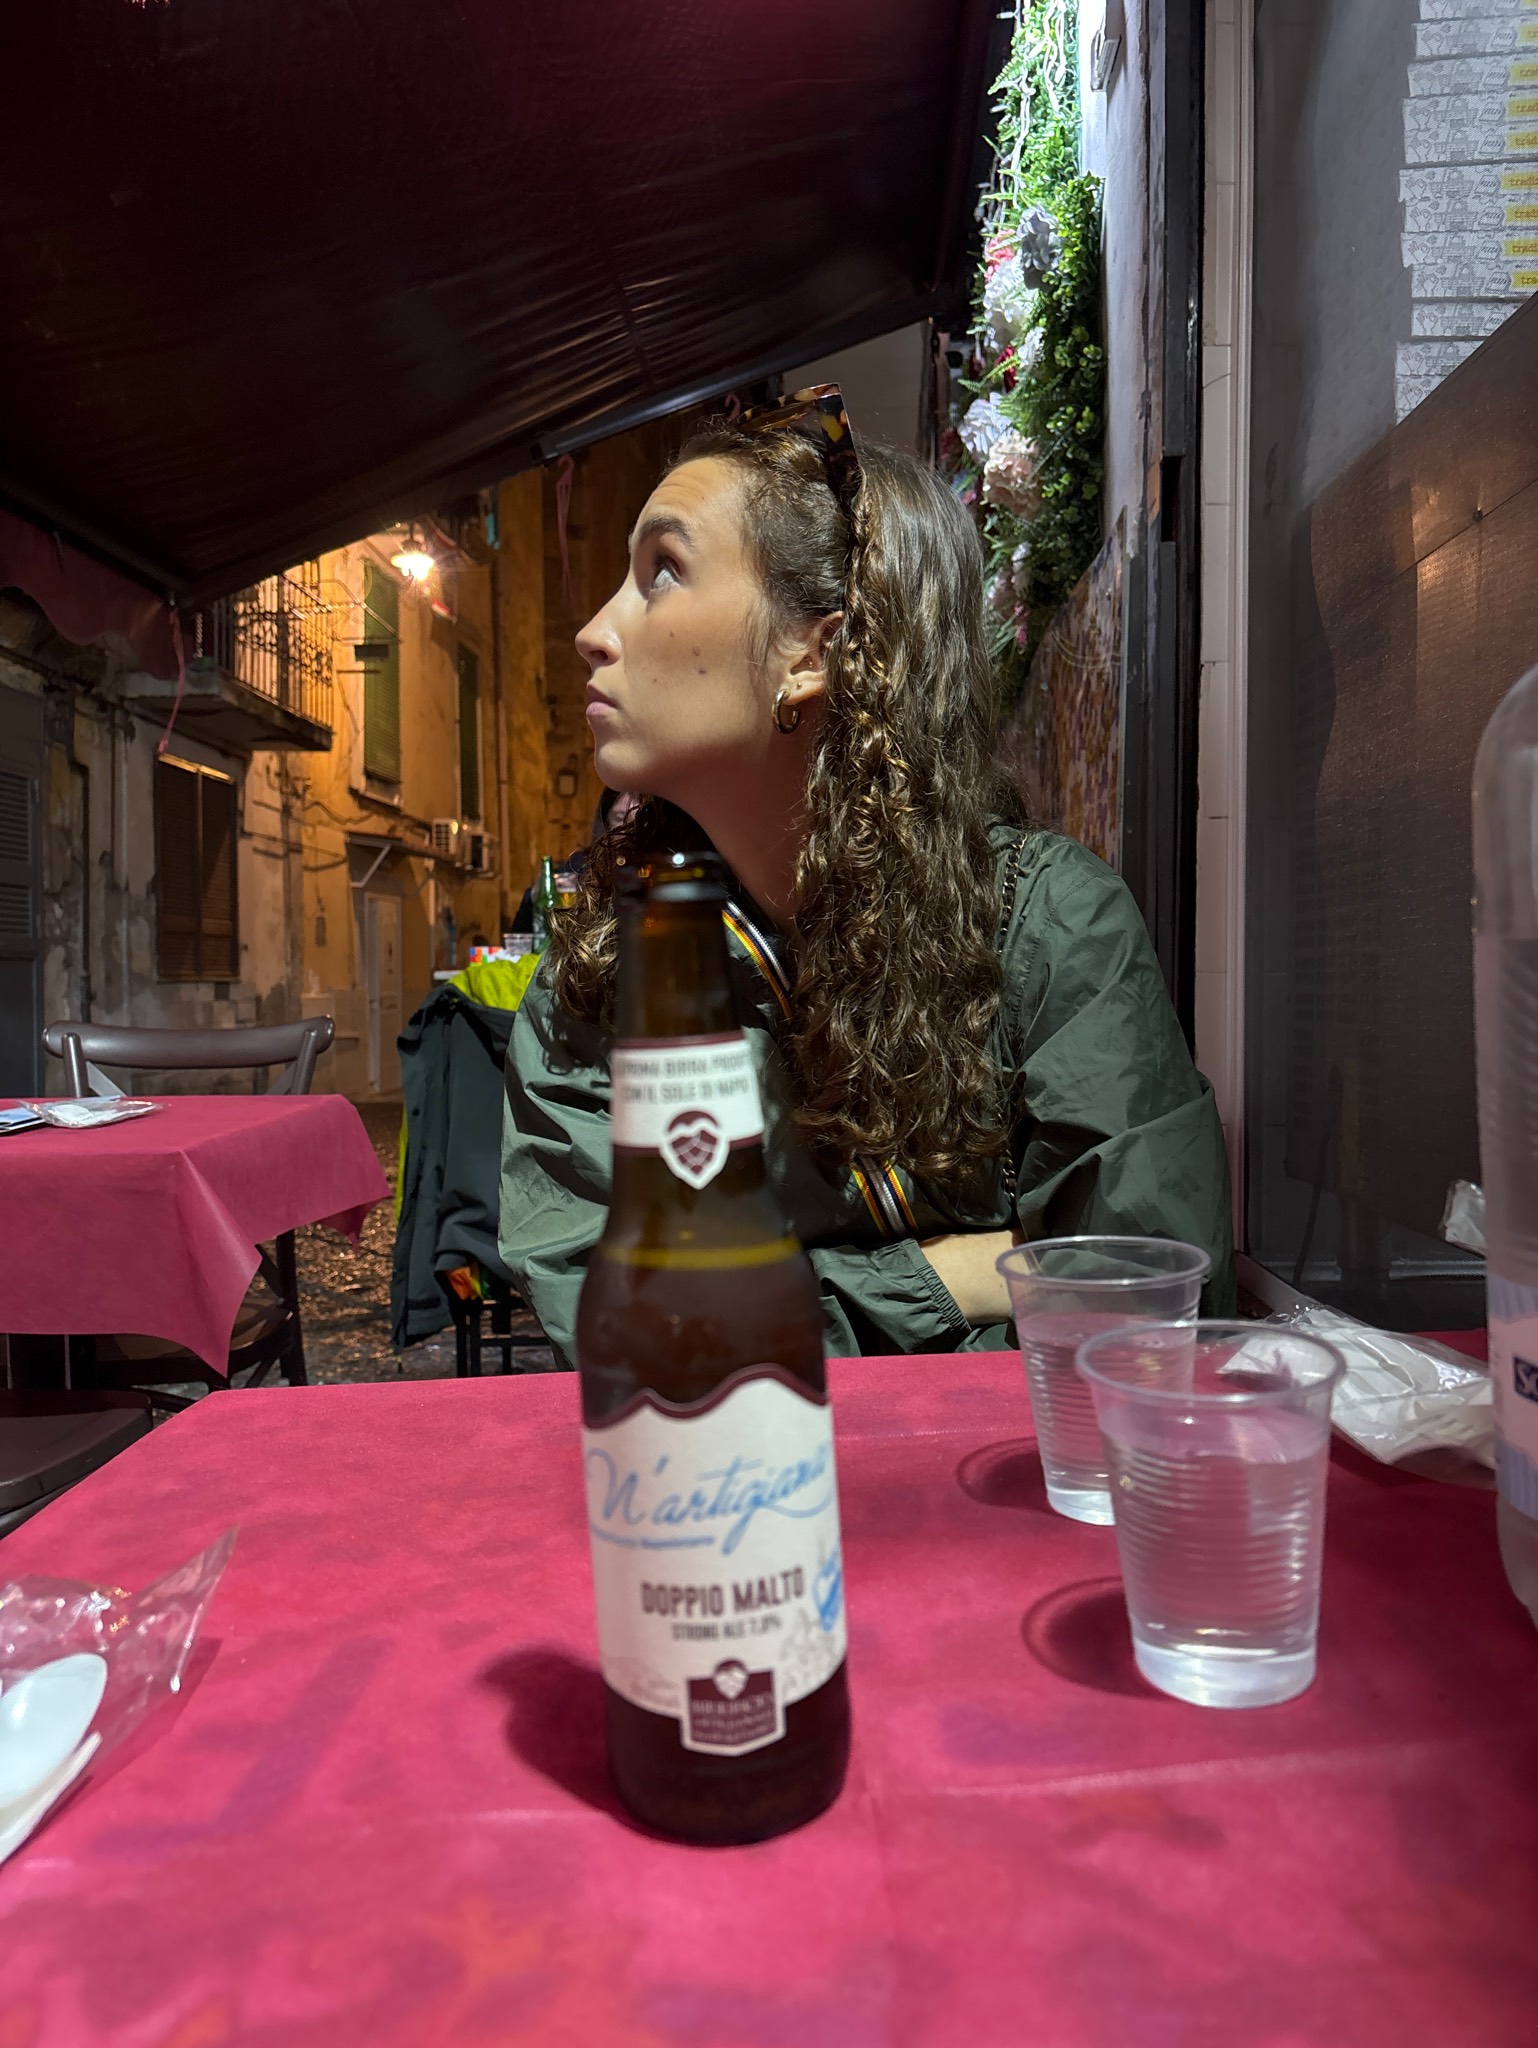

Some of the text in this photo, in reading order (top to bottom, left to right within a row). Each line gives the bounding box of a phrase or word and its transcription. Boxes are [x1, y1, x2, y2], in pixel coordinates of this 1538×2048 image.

[640, 1564, 805, 1617] DOPPIO MALTO
[671, 1621, 719, 1642] STRONG
[723, 1619, 747, 1640] ALE
